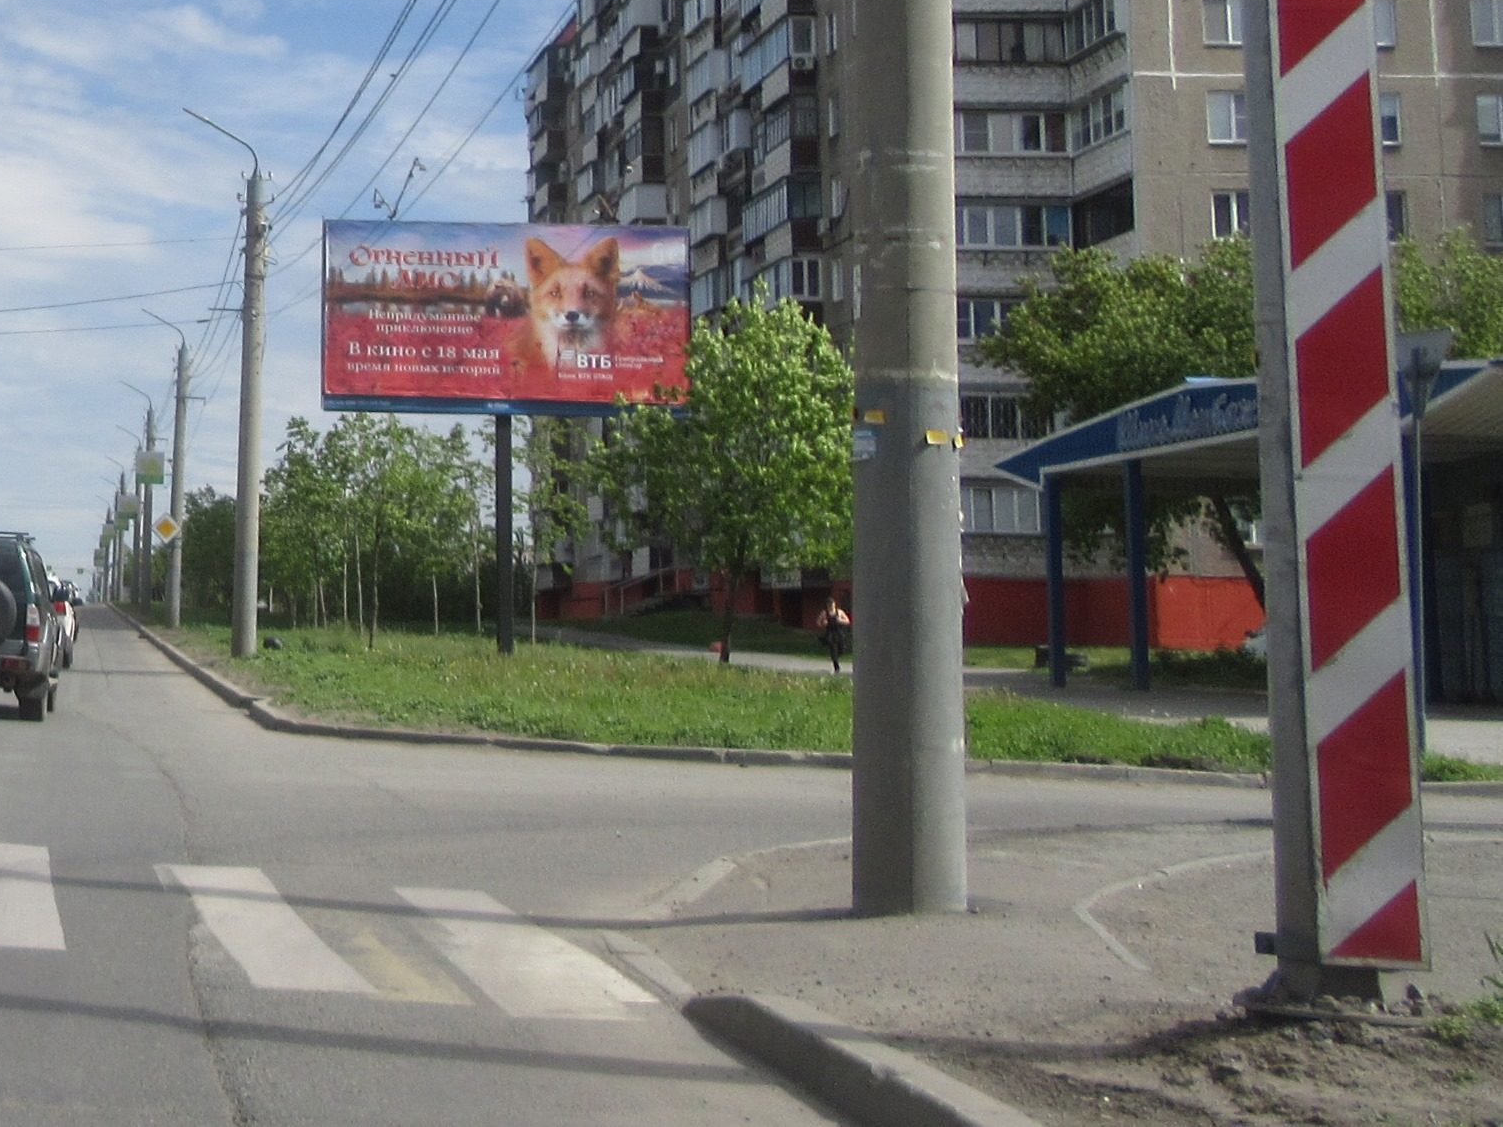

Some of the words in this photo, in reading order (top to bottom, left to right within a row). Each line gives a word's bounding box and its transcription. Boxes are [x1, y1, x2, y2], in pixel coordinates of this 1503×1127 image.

[368, 308, 481, 323] Непридуманное
[376, 324, 474, 335] приключение
[349, 341, 361, 356] В
[367, 344, 417, 357] кино
[422, 346, 432, 358] с
[437, 345, 457, 358] 18
[463, 347, 500, 360] мая
[394, 363, 440, 374] новых
[443, 361, 500, 377] историй
[577, 353, 612, 369] ВТБ
